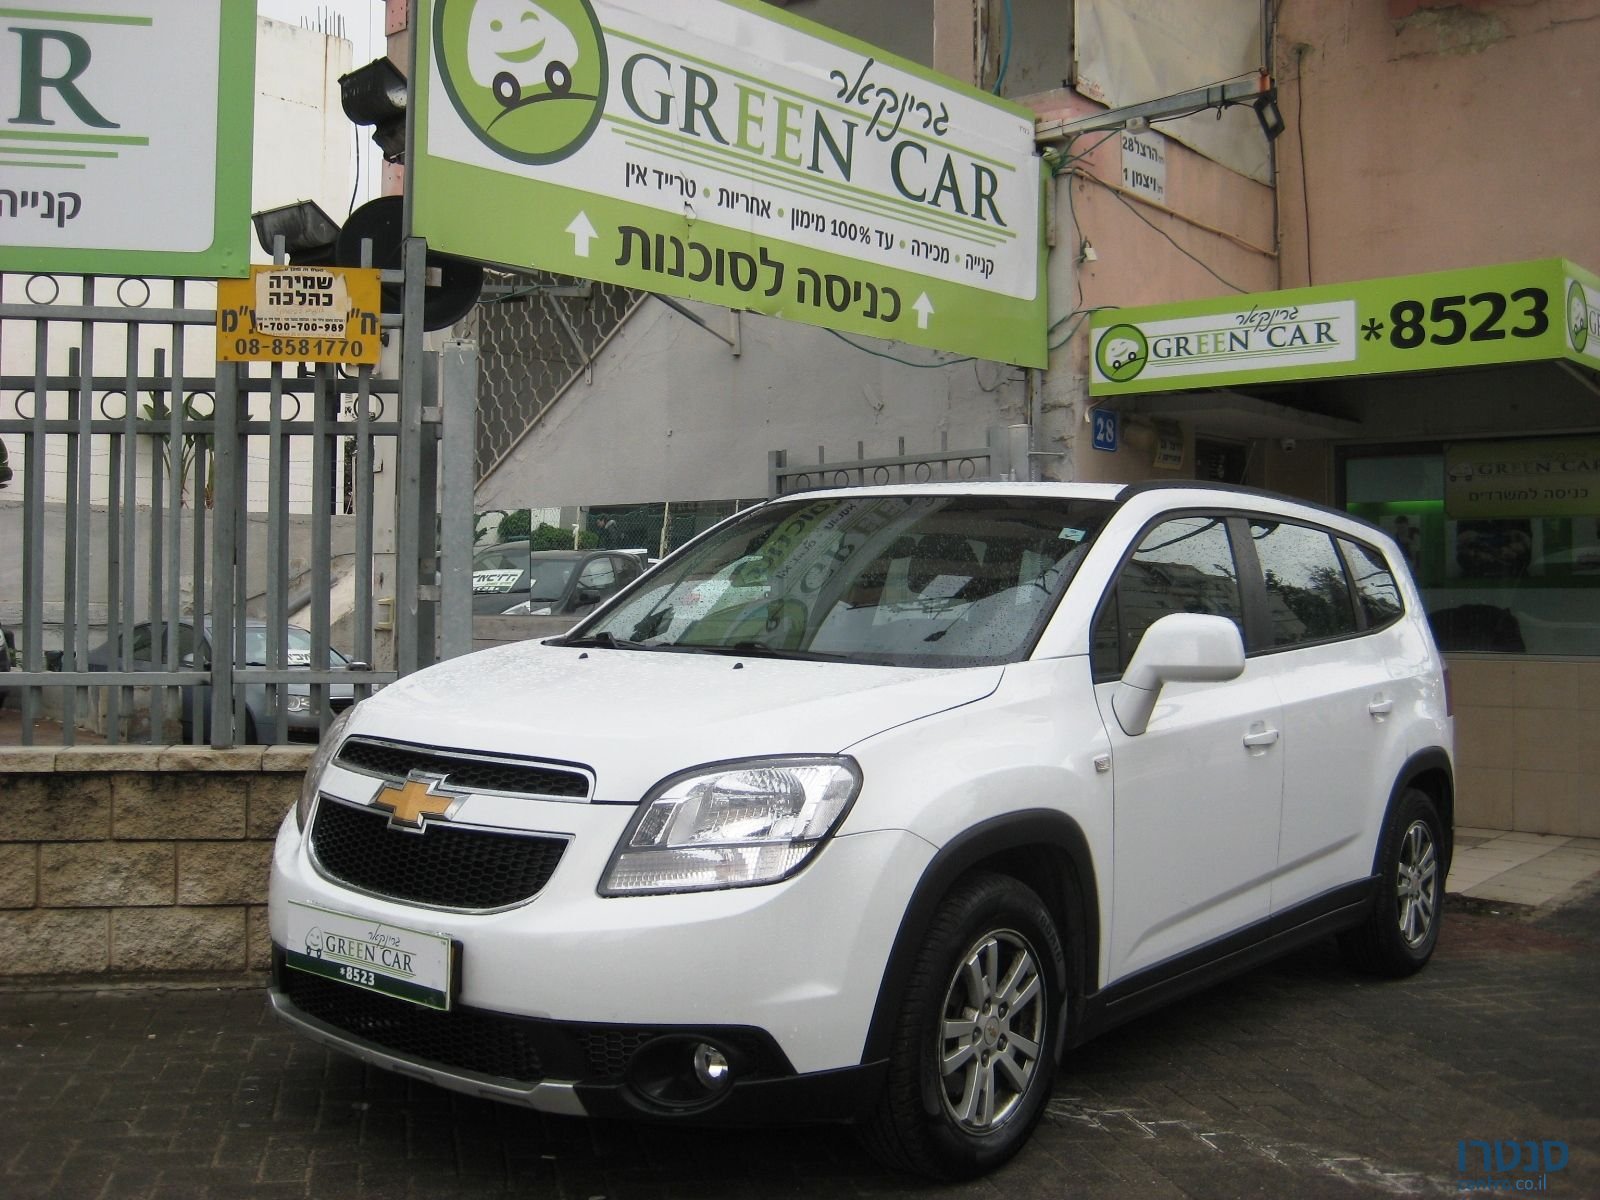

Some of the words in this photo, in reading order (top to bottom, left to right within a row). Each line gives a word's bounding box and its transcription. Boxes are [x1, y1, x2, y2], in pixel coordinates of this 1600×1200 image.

[829, 57, 949, 142] גרינקאר
[621, 53, 858, 182] GREEN
[891, 140, 1007, 227] CAR
[625, 161, 648, 187] אין
[652, 168, 697, 199] טרייד
[1122, 167, 1128, 181] 1
[0, 189, 82, 228] קנייה
[717, 186, 771, 219] אחריות
[790, 206, 826, 233] מימון
[830, 219, 871, 246] 100%
[874, 229, 895, 251] עד
[910, 238, 950, 264] מכירה
[615, 225, 785, 296] לסוכנות
[965, 252, 995, 279] קנייה
[269, 275, 334, 290] שמירה
[797, 266, 902, 322] כניסה
[268, 290, 333, 307] כהלכה
[258, 322, 344, 333] 1-700-700-989
[1235, 304, 1299, 332] גרינקאר
[235, 338, 363, 357] 08-8581770
[1152, 329, 1250, 360] GREEN
[1266, 321, 1338, 348] CAR
[1096, 418, 1114, 442] 28
[1478, 462, 1551, 475] GREEN
[1468, 487, 1538, 502] למשרדים
[1543, 488, 1589, 500] כניסה
[367, 924, 401, 949] גרינקאר
[326, 935, 375, 962] GREEN
[381, 949, 413, 973] CAR
